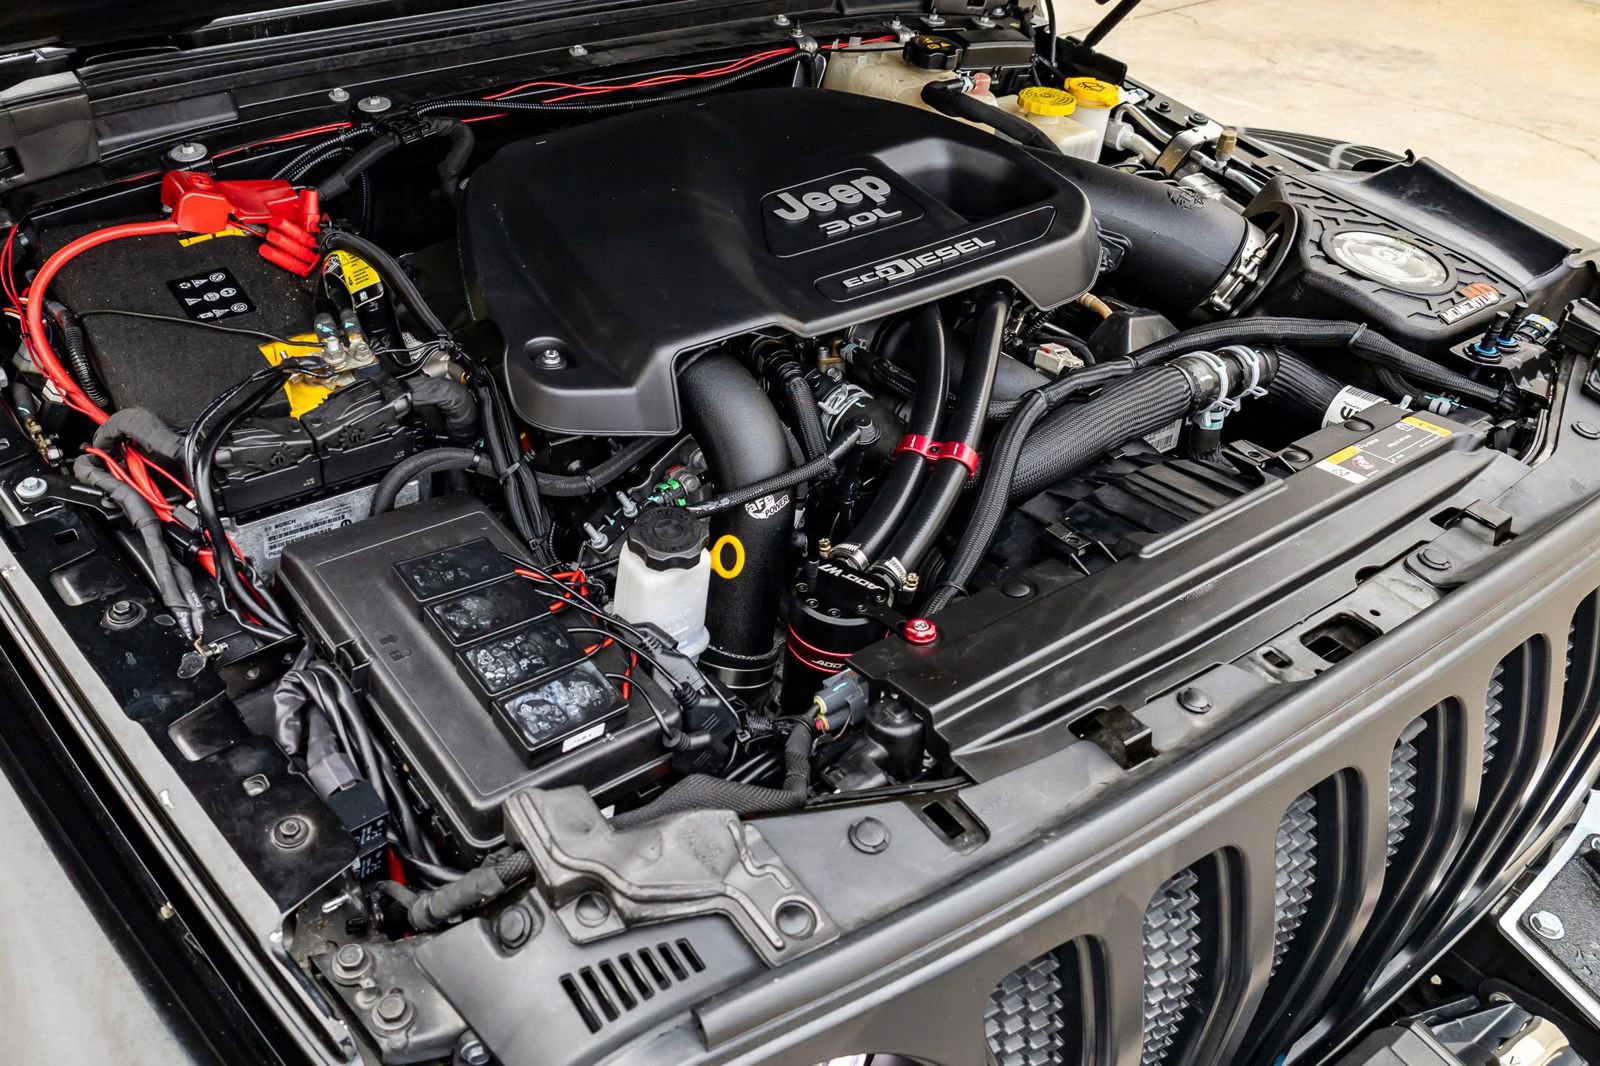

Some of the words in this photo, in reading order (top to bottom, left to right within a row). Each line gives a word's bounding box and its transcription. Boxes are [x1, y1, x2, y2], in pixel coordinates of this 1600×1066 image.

[772, 175, 892, 222] Jeep
[818, 208, 903, 237] 3.0L
[1440, 291, 1500, 323] MOMENTUM
[745, 494, 775, 514] aFe
[764, 494, 790, 519] POWER
[274, 518, 297, 529] BOSCH
